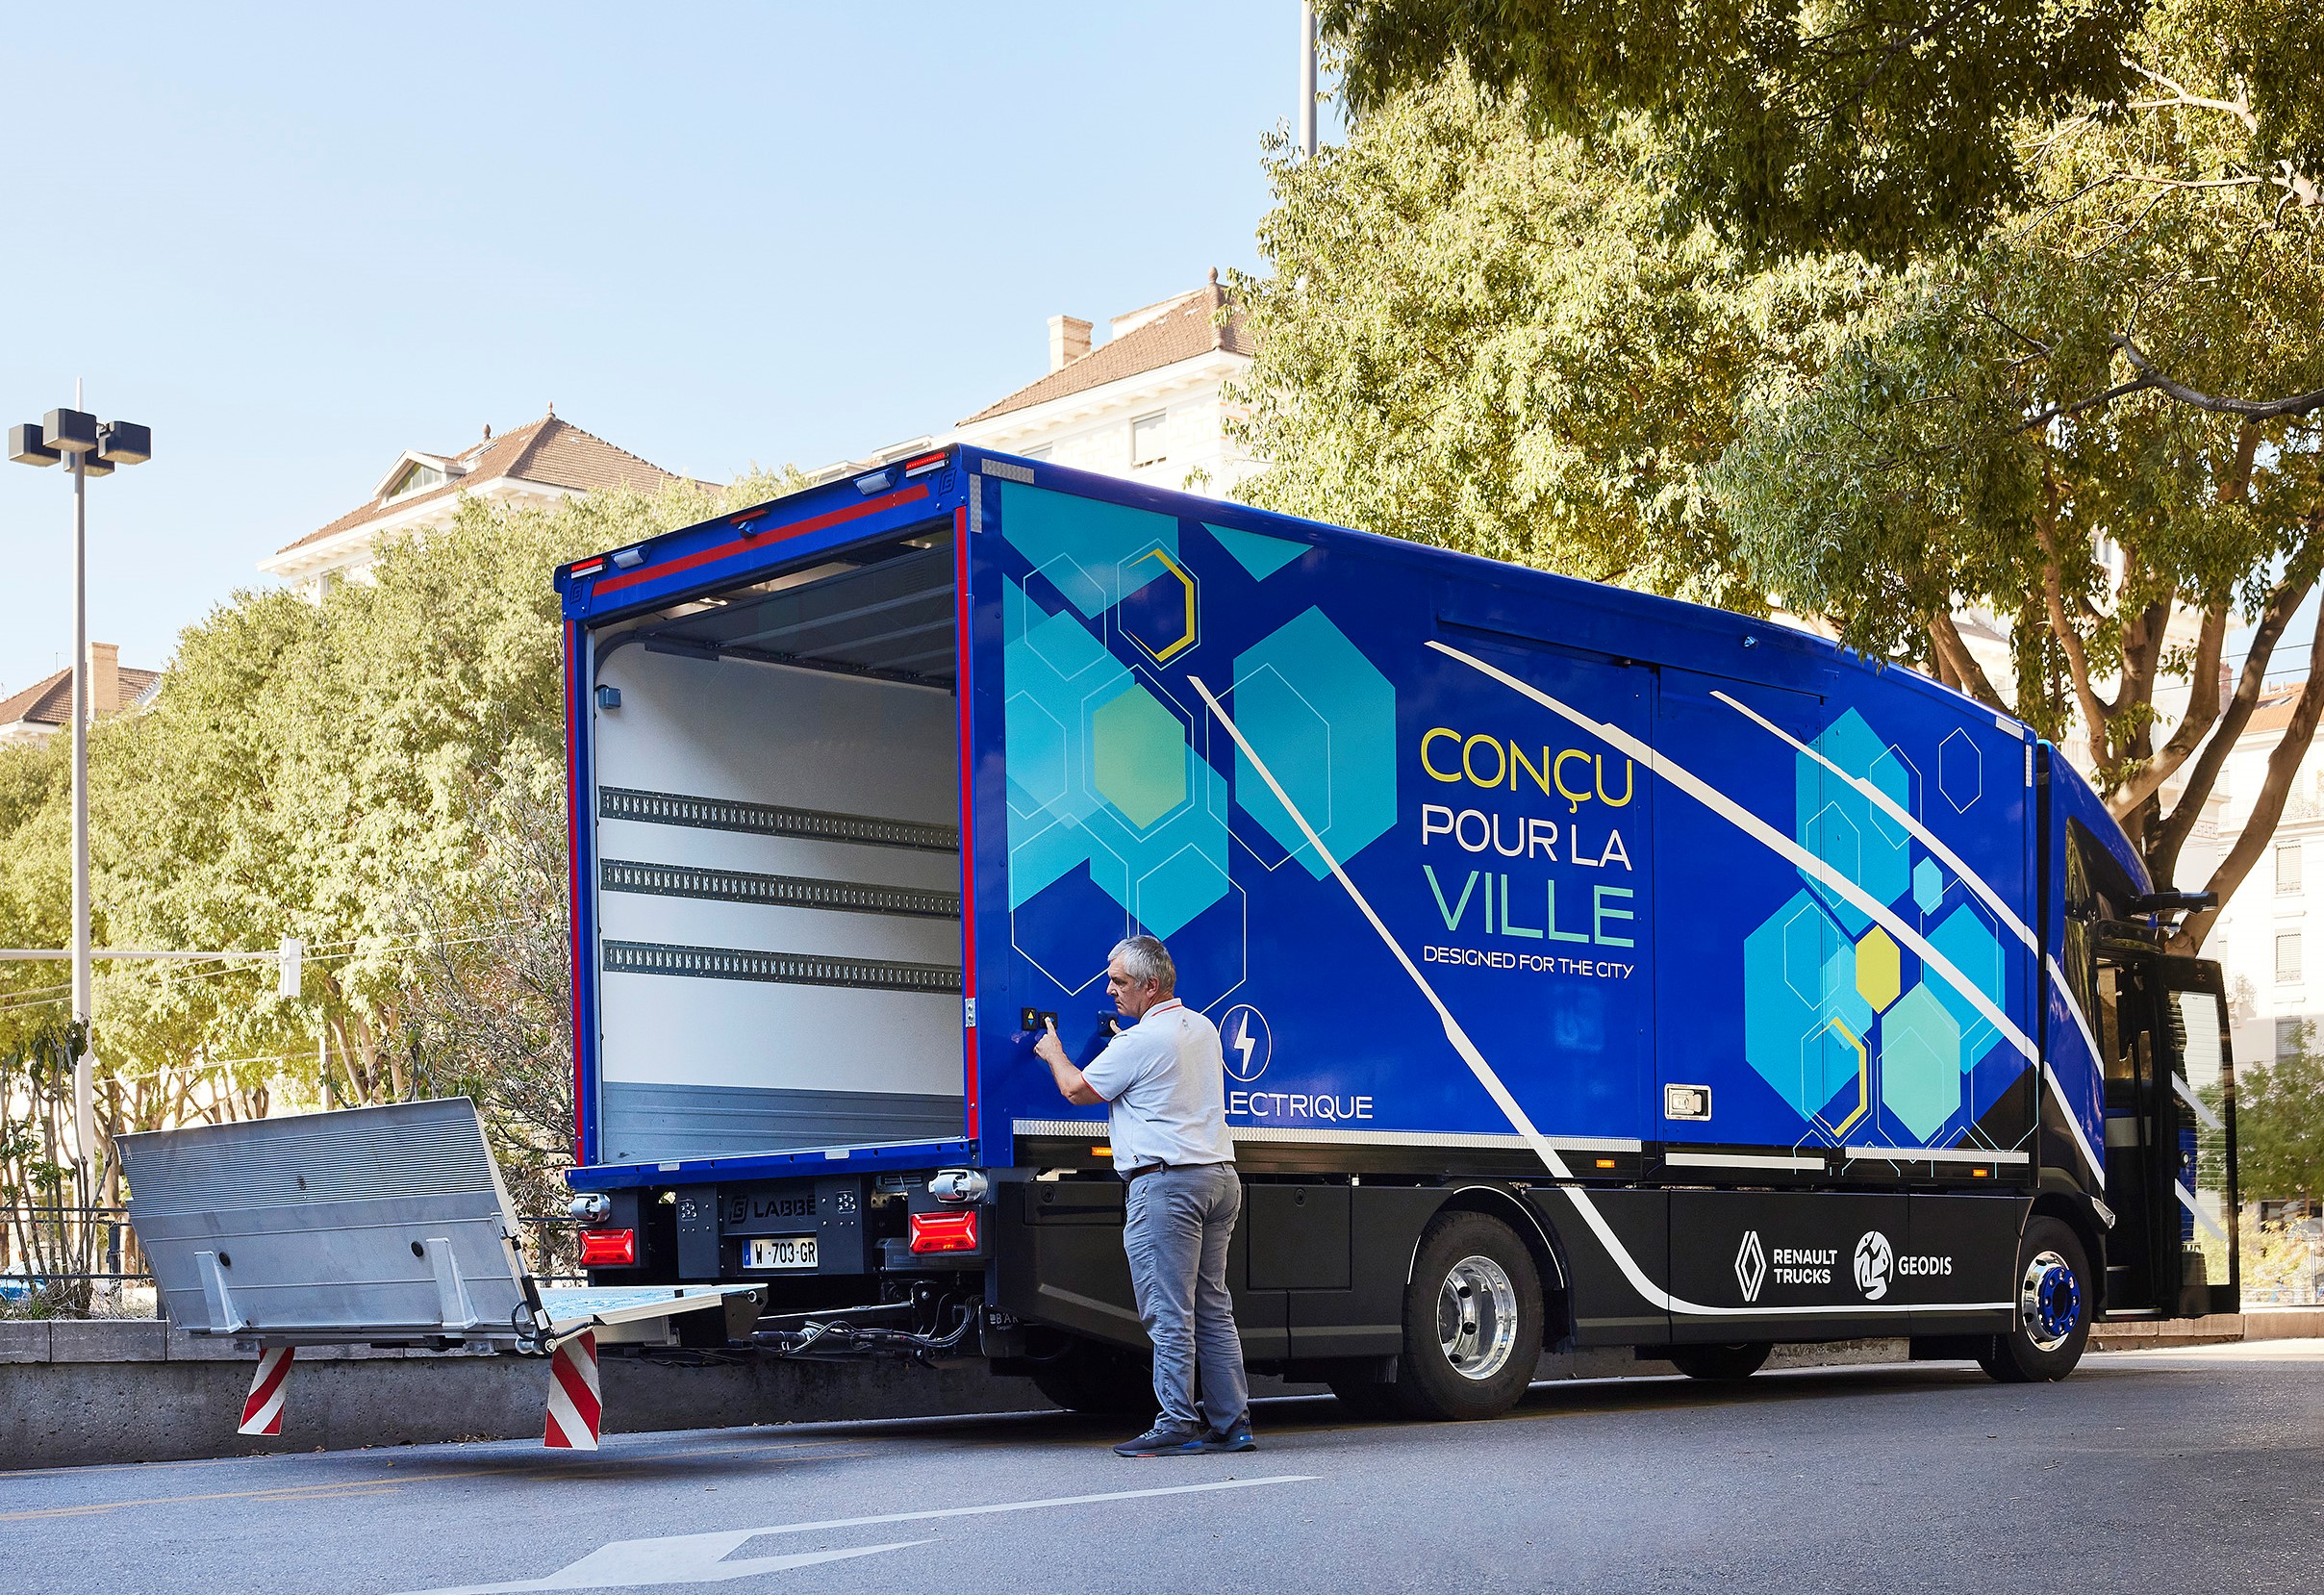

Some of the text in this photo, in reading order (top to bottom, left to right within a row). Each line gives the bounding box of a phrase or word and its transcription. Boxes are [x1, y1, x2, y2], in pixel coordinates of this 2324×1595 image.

[1420, 727, 1633, 814] CONÇU
[1421, 803, 1632, 872] POUR LA
[1423, 864, 1634, 949] VILLE
[1424, 945, 1635, 979] DESIGNED FOR THE CITY
[1225, 1091, 1374, 1123] ECTRIQUE
[1773, 1249, 1838, 1265] RENAULT
[1898, 1255, 1953, 1276] GEODIS
[1773, 1268, 1831, 1284] TRUCKS
